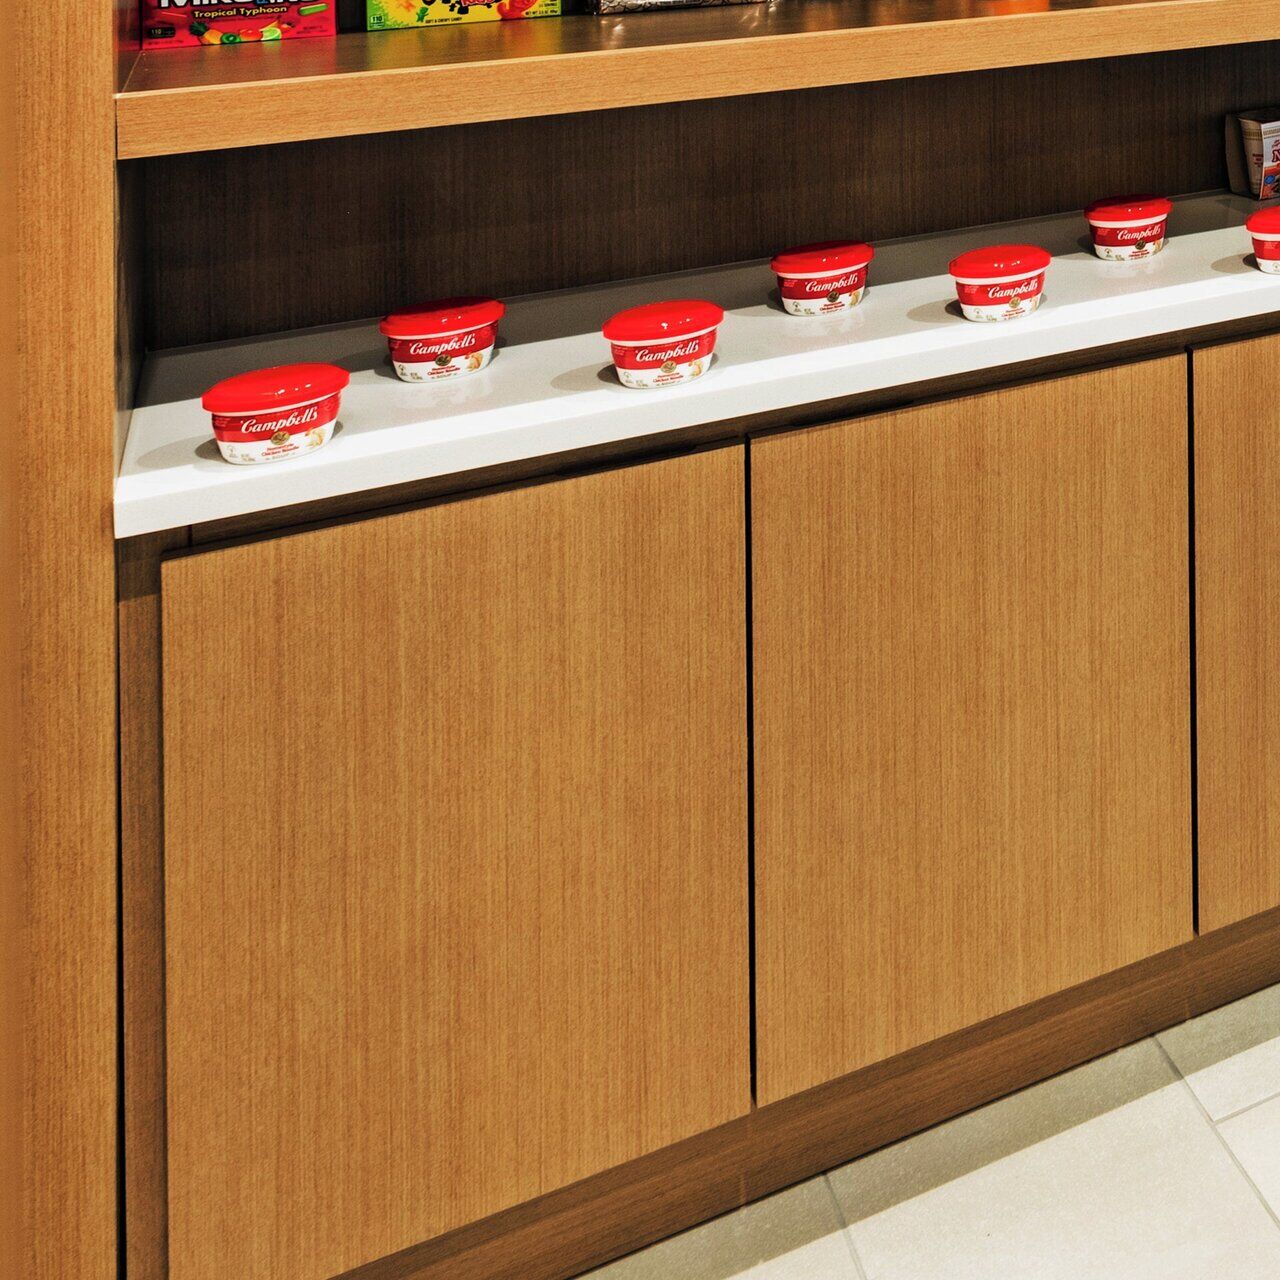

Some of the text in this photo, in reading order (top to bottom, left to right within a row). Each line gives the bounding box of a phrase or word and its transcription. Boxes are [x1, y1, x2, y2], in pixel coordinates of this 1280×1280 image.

[193, 6, 288, 19] Tropical Typhoon
[1117, 224, 1161, 241] Campbell's
[806, 275, 858, 293] Campbell's
[988, 280, 1038, 299] Campbell's
[410, 333, 475, 356] Campbell's
[636, 340, 699, 363] Campbell's
[241, 406, 318, 434] Campbell's
